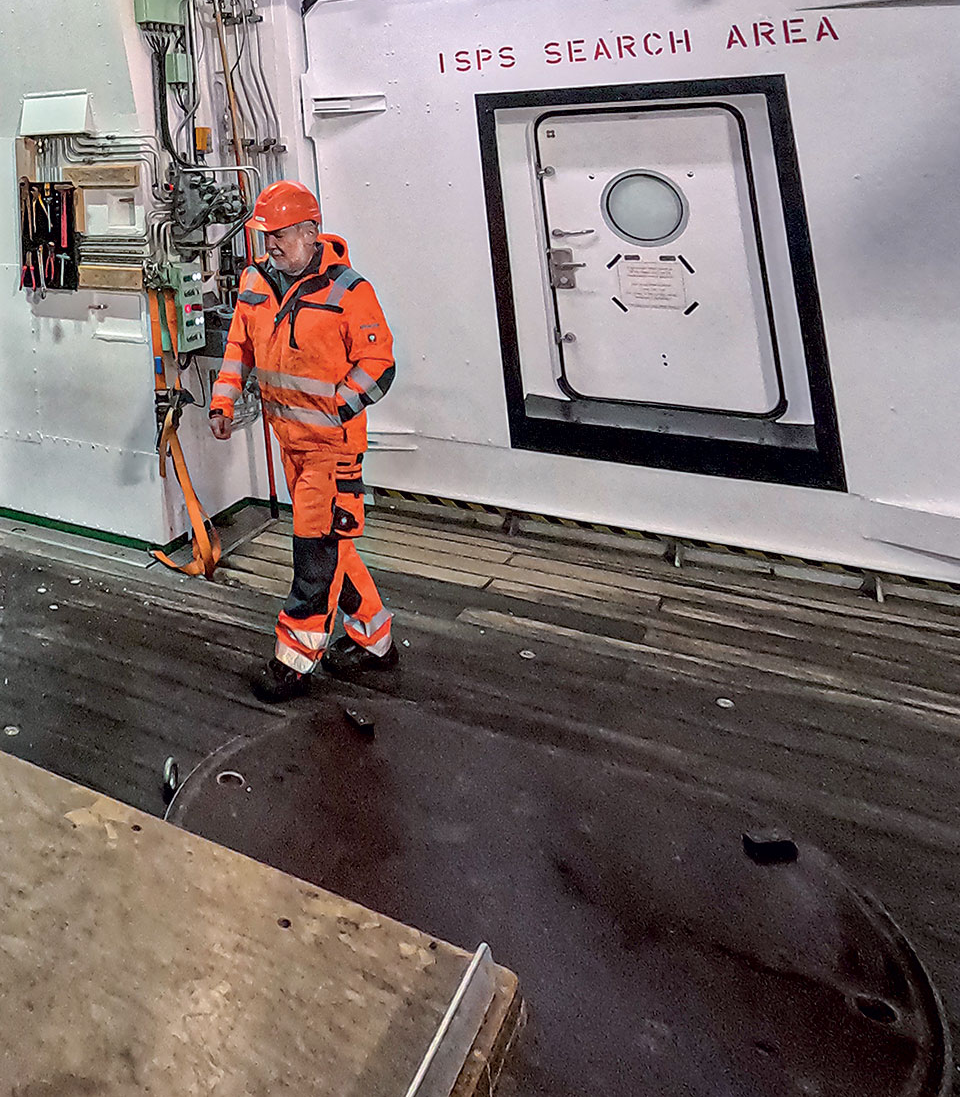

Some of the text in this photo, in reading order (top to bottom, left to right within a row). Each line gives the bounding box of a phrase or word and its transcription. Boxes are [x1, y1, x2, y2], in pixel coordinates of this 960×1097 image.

[438, 15, 839, 74] ISPS SEARCH AREA
